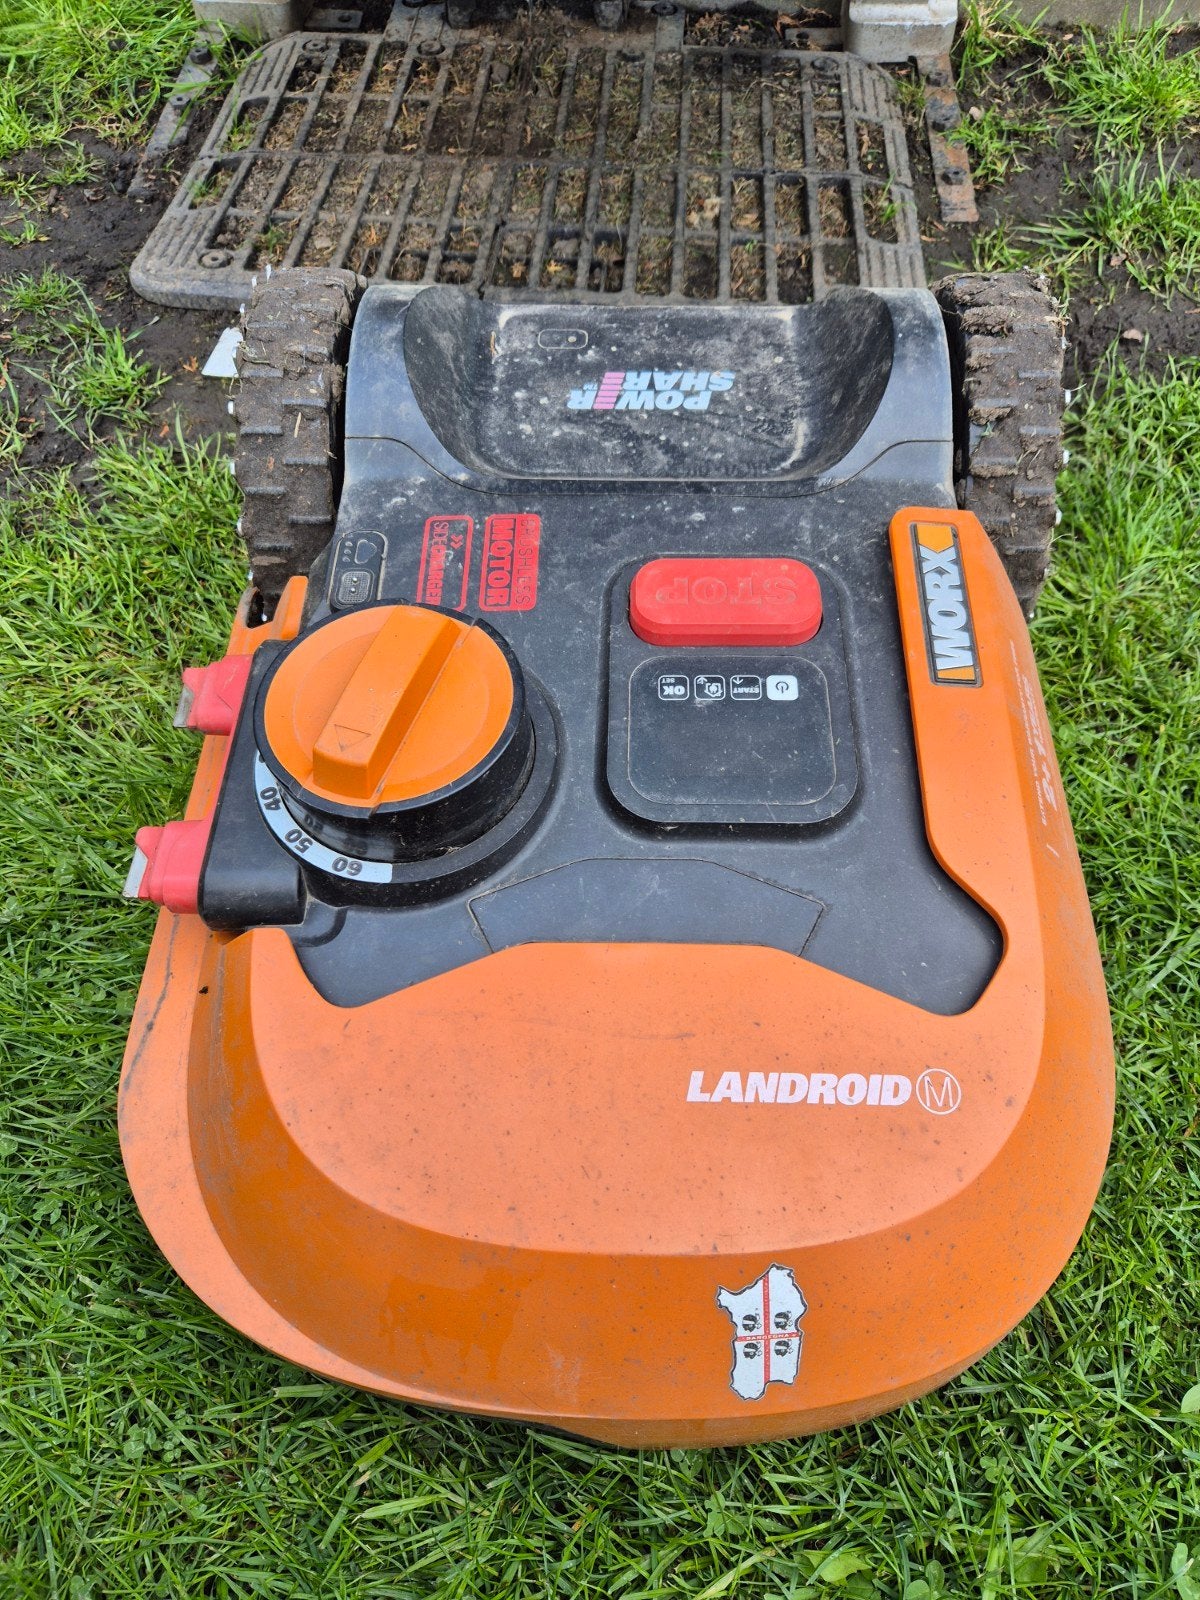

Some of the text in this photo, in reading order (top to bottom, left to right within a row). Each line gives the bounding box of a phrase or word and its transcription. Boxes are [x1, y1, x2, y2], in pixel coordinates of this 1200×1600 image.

[566, 389, 713, 410] POWER
[486, 519, 515, 606] MOTOR
[516, 519, 537, 605] BRUSHLESS
[655, 576, 798, 605] STOP
[919, 545, 974, 670] WORX
[662, 685, 686, 696] OK
[260, 786, 281, 811] 40
[285, 829, 313, 854] 50
[332, 857, 363, 876] 60
[686, 1070, 912, 1106] LANDROID
